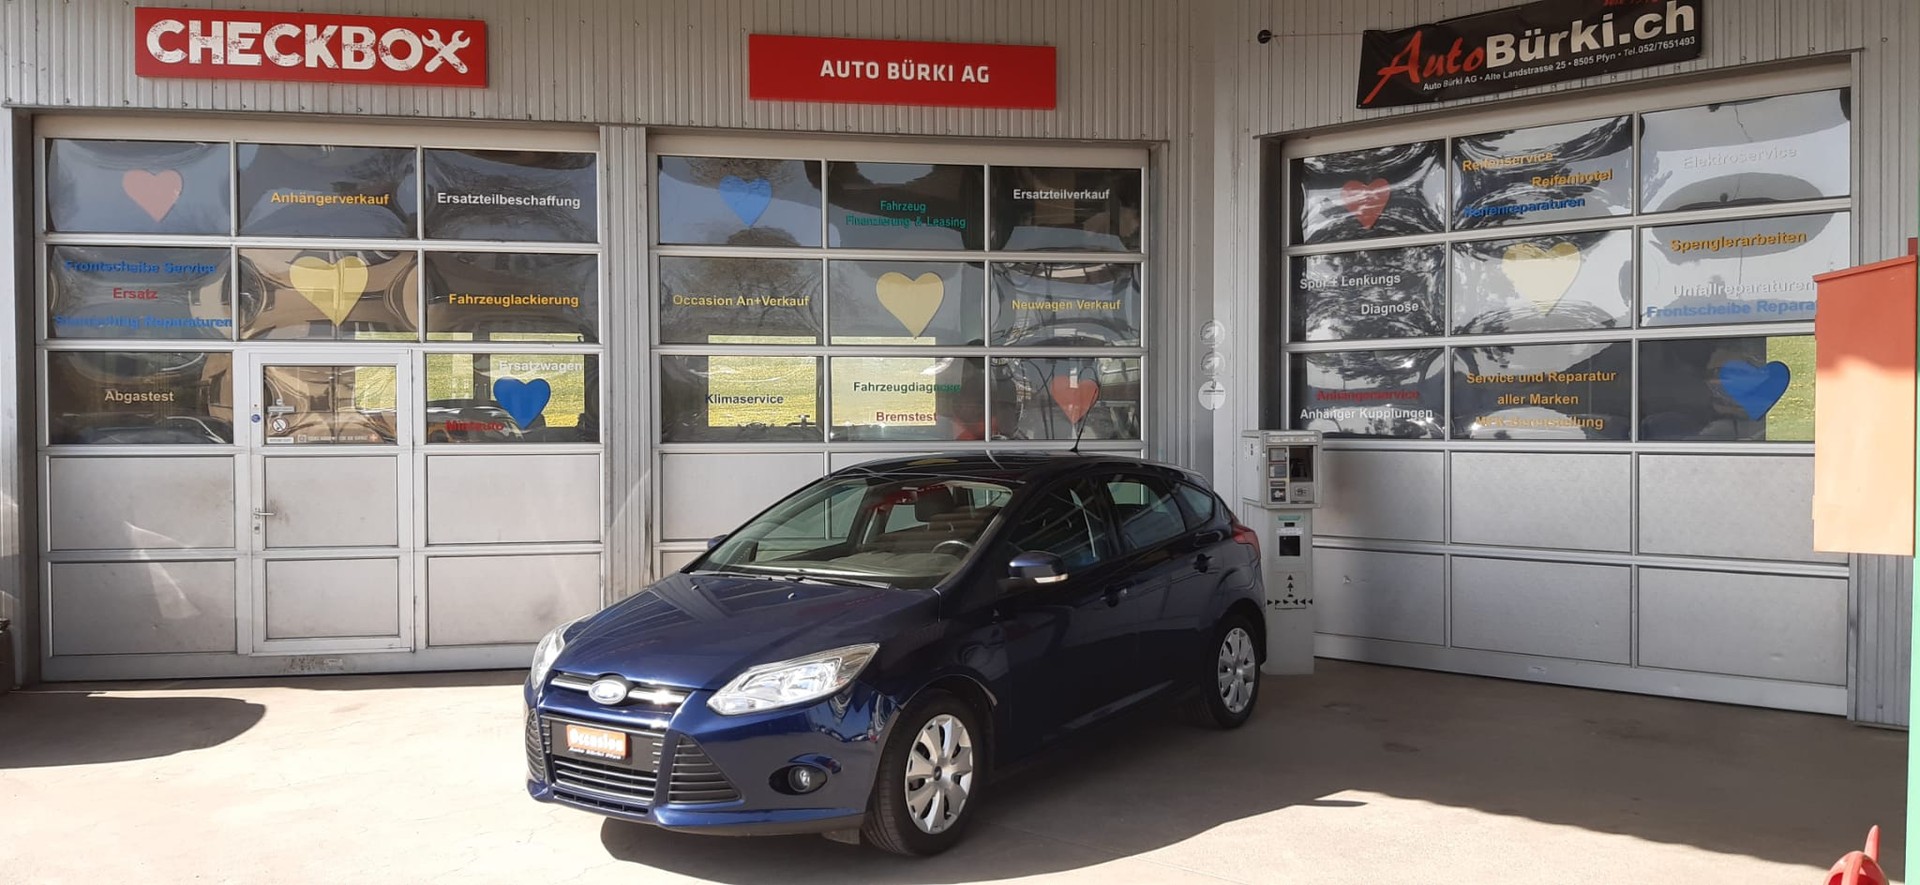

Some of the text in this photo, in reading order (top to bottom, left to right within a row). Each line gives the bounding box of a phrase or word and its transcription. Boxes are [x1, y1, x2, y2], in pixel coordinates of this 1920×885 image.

[146, 20, 471, 74] CHECKBOX
[820, 60, 990, 84] AUTO BÜRKI AG
[1423, 81, 1442, 91] Auto
[1443, 78, 1463, 88] Bürki
[1464, 75, 1478, 84] AG
[1485, 73, 1501, 81] Alte
[1503, 64, 1553, 79] Landstrasse
[1555, 61, 1567, 70] 25
[1574, 57, 1594, 67] 8505
[1596, 53, 1616, 64] Pfyn
[1462, 152, 1554, 172] Reifenservice
[1683, 146, 1798, 169] Elektroservice
[1532, 169, 1613, 188] Reifenhotel
[270, 191, 389, 208] Anhängerverkauf
[437, 192, 581, 209] Ersatzteilbeschaffung
[1013, 188, 1110, 202] Ersatzteilverkauf
[880, 200, 927, 213] Fahrzeug
[927, 216, 966, 229] Leasing
[1671, 231, 1808, 253] Spenglerarbeiten
[65, 260, 217, 274] Frontscheibe Service
[1300, 279, 1326, 291] Spur
[1341, 274, 1401, 289] Lenkungs
[1673, 280, 1815, 298] Unfallreparaturen
[113, 287, 158, 300] Ersatz
[448, 292, 580, 308] Fahrzeuglackierung
[673, 293, 810, 307] Occasion An+Verkauf
[1012, 298, 1121, 313] Neuwagen Verkauf
[1361, 302, 1419, 316] Diagnose
[1647, 300, 1815, 318] Frontscheibe Repara
[499, 360, 584, 373] Ersatzwagen
[1466, 370, 1617, 384] Service und Reparatur
[853, 381, 961, 394] Fahrzeugdiagnose
[104, 389, 175, 404] Abgastest
[705, 392, 784, 406] Klimaservice
[1497, 393, 1579, 405] aller Marken
[876, 411, 938, 422] Bremstest
[1300, 408, 1433, 421] Anhänger Kupplungen
